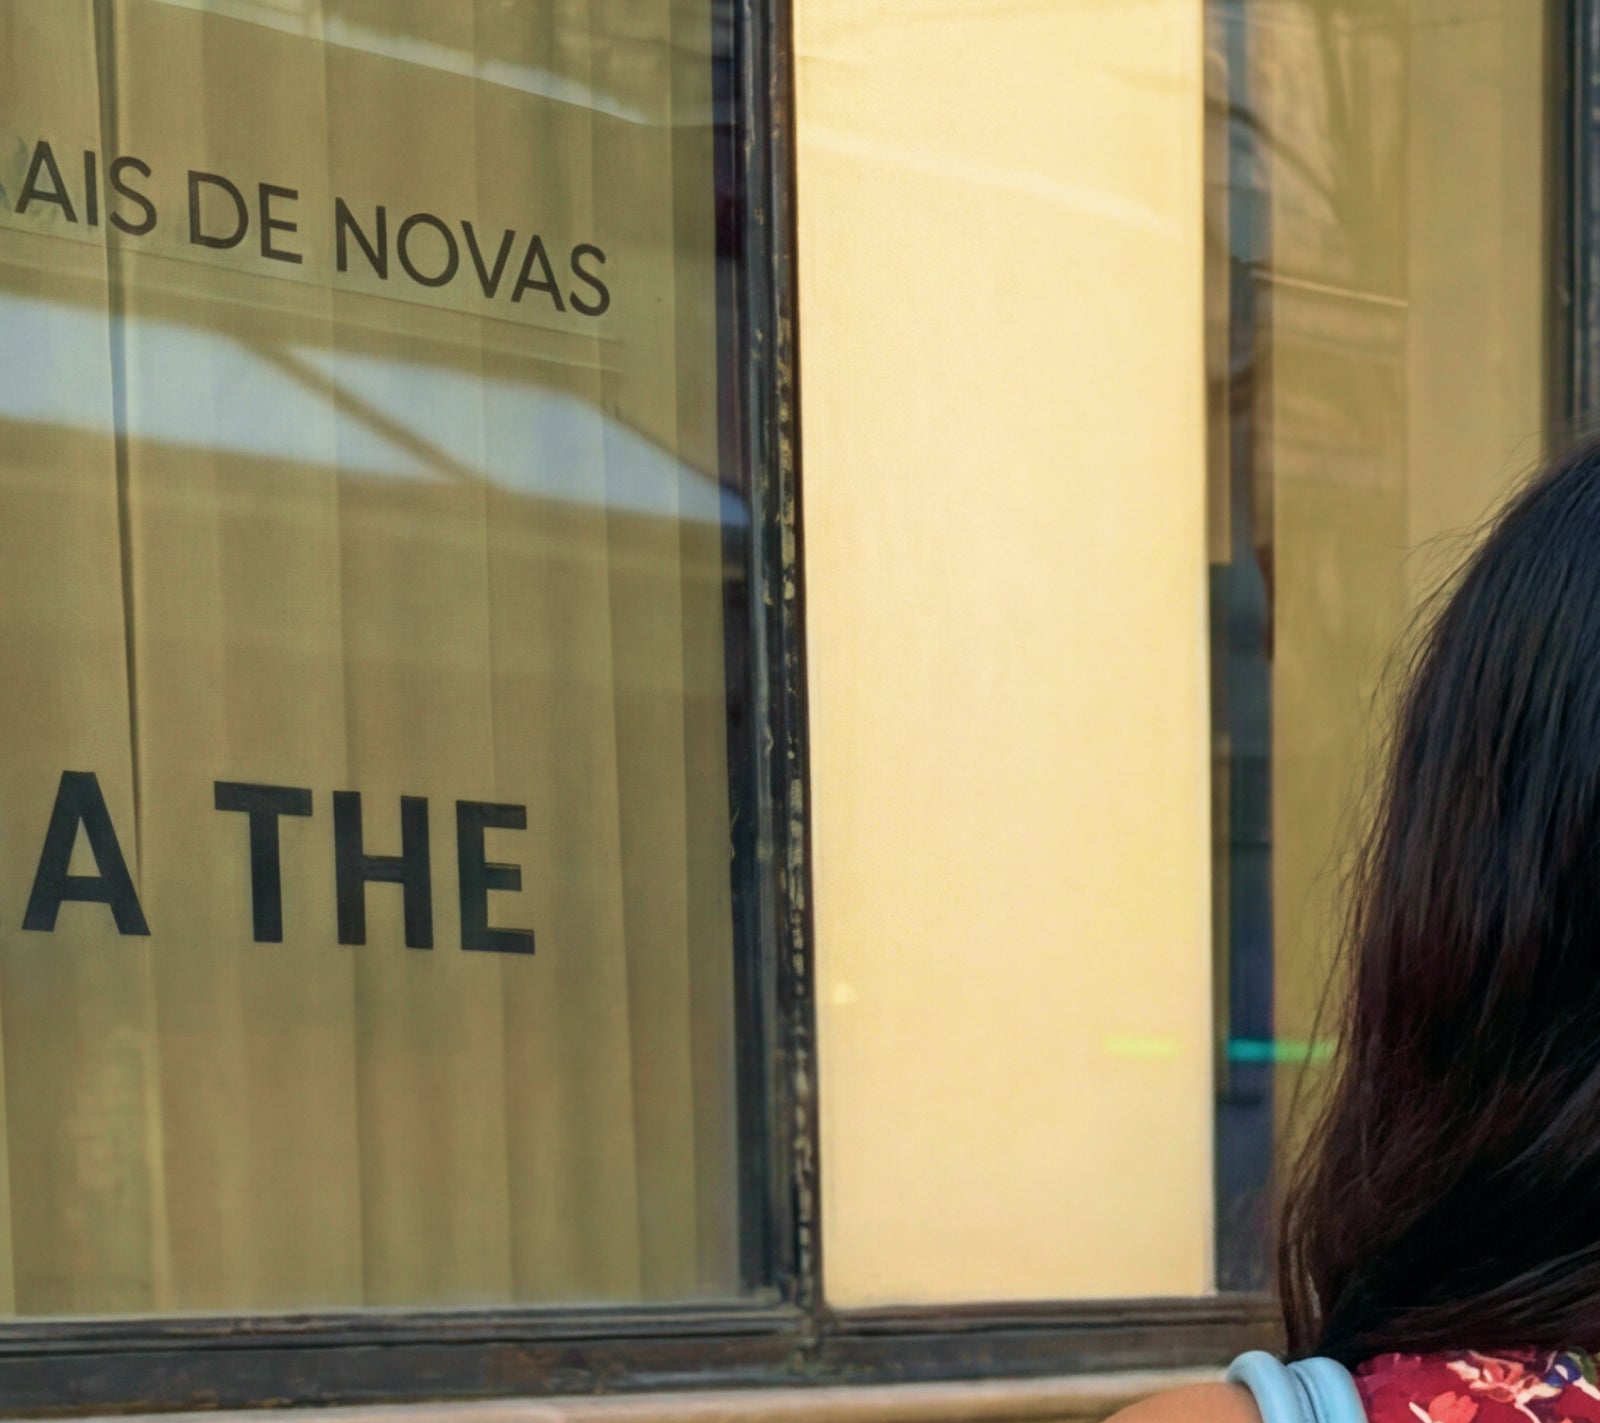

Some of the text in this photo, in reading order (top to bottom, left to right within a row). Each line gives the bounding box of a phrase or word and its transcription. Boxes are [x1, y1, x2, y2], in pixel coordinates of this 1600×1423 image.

[14, 139, 611, 318] AIS DE NOVAS
[22, 770, 536, 955] A THE
